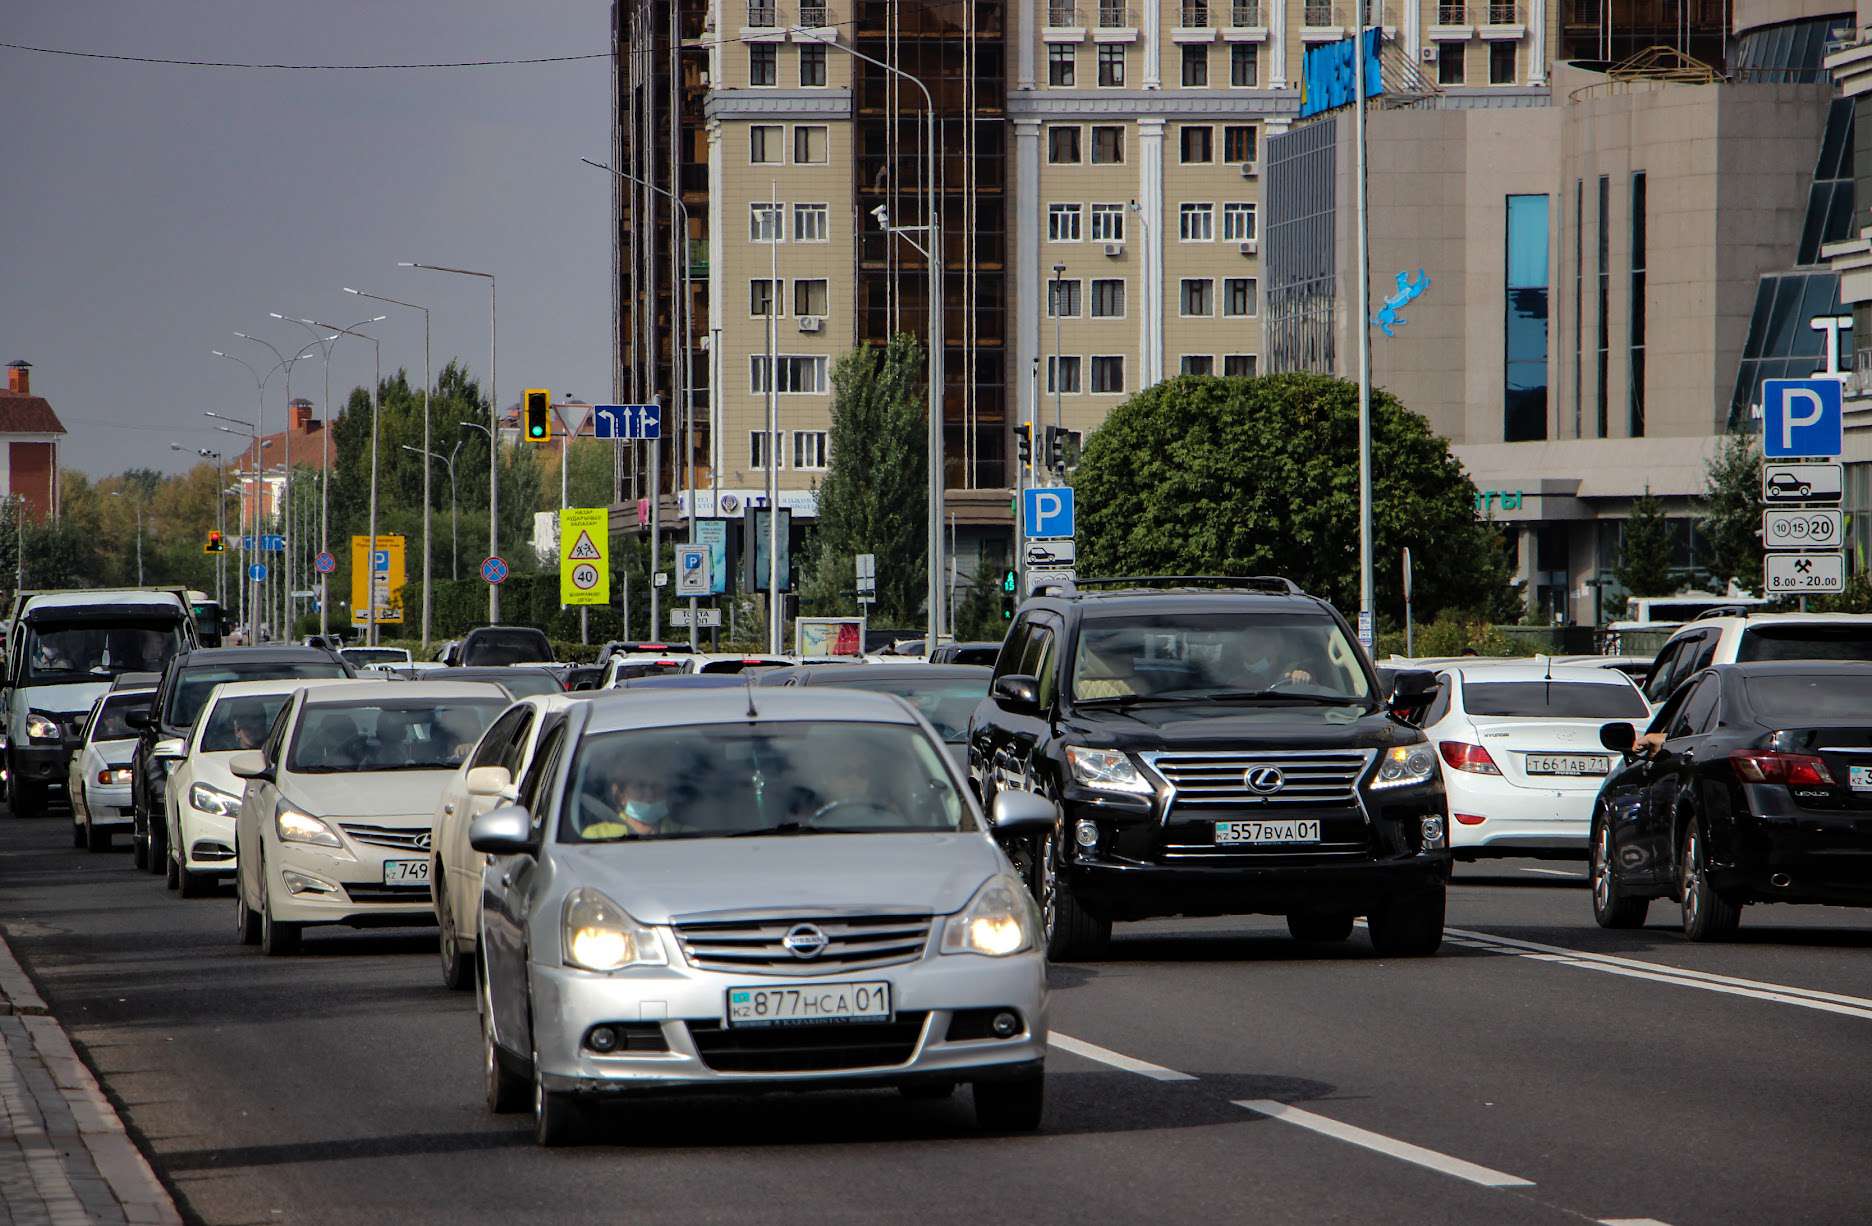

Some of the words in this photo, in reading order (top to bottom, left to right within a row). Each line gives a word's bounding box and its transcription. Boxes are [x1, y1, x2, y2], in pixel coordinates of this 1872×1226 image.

[1782, 388, 1824, 449] P
[1035, 493, 1062, 533] P
[1776, 524, 1786, 533] 10
[1793, 523, 1804, 532] 15
[1811, 521, 1830, 534] 20
[689, 557, 698, 568] P
[577, 571, 593, 582] 40
[1773, 576, 1796, 586] 8.00
[1806, 576, 1837, 586] 20.00
[1852, 776, 1863, 784] KZ
[1216, 832, 1229, 840] KZ
[399, 863, 428, 879] 749
[733, 1006, 751, 1017] KZ
